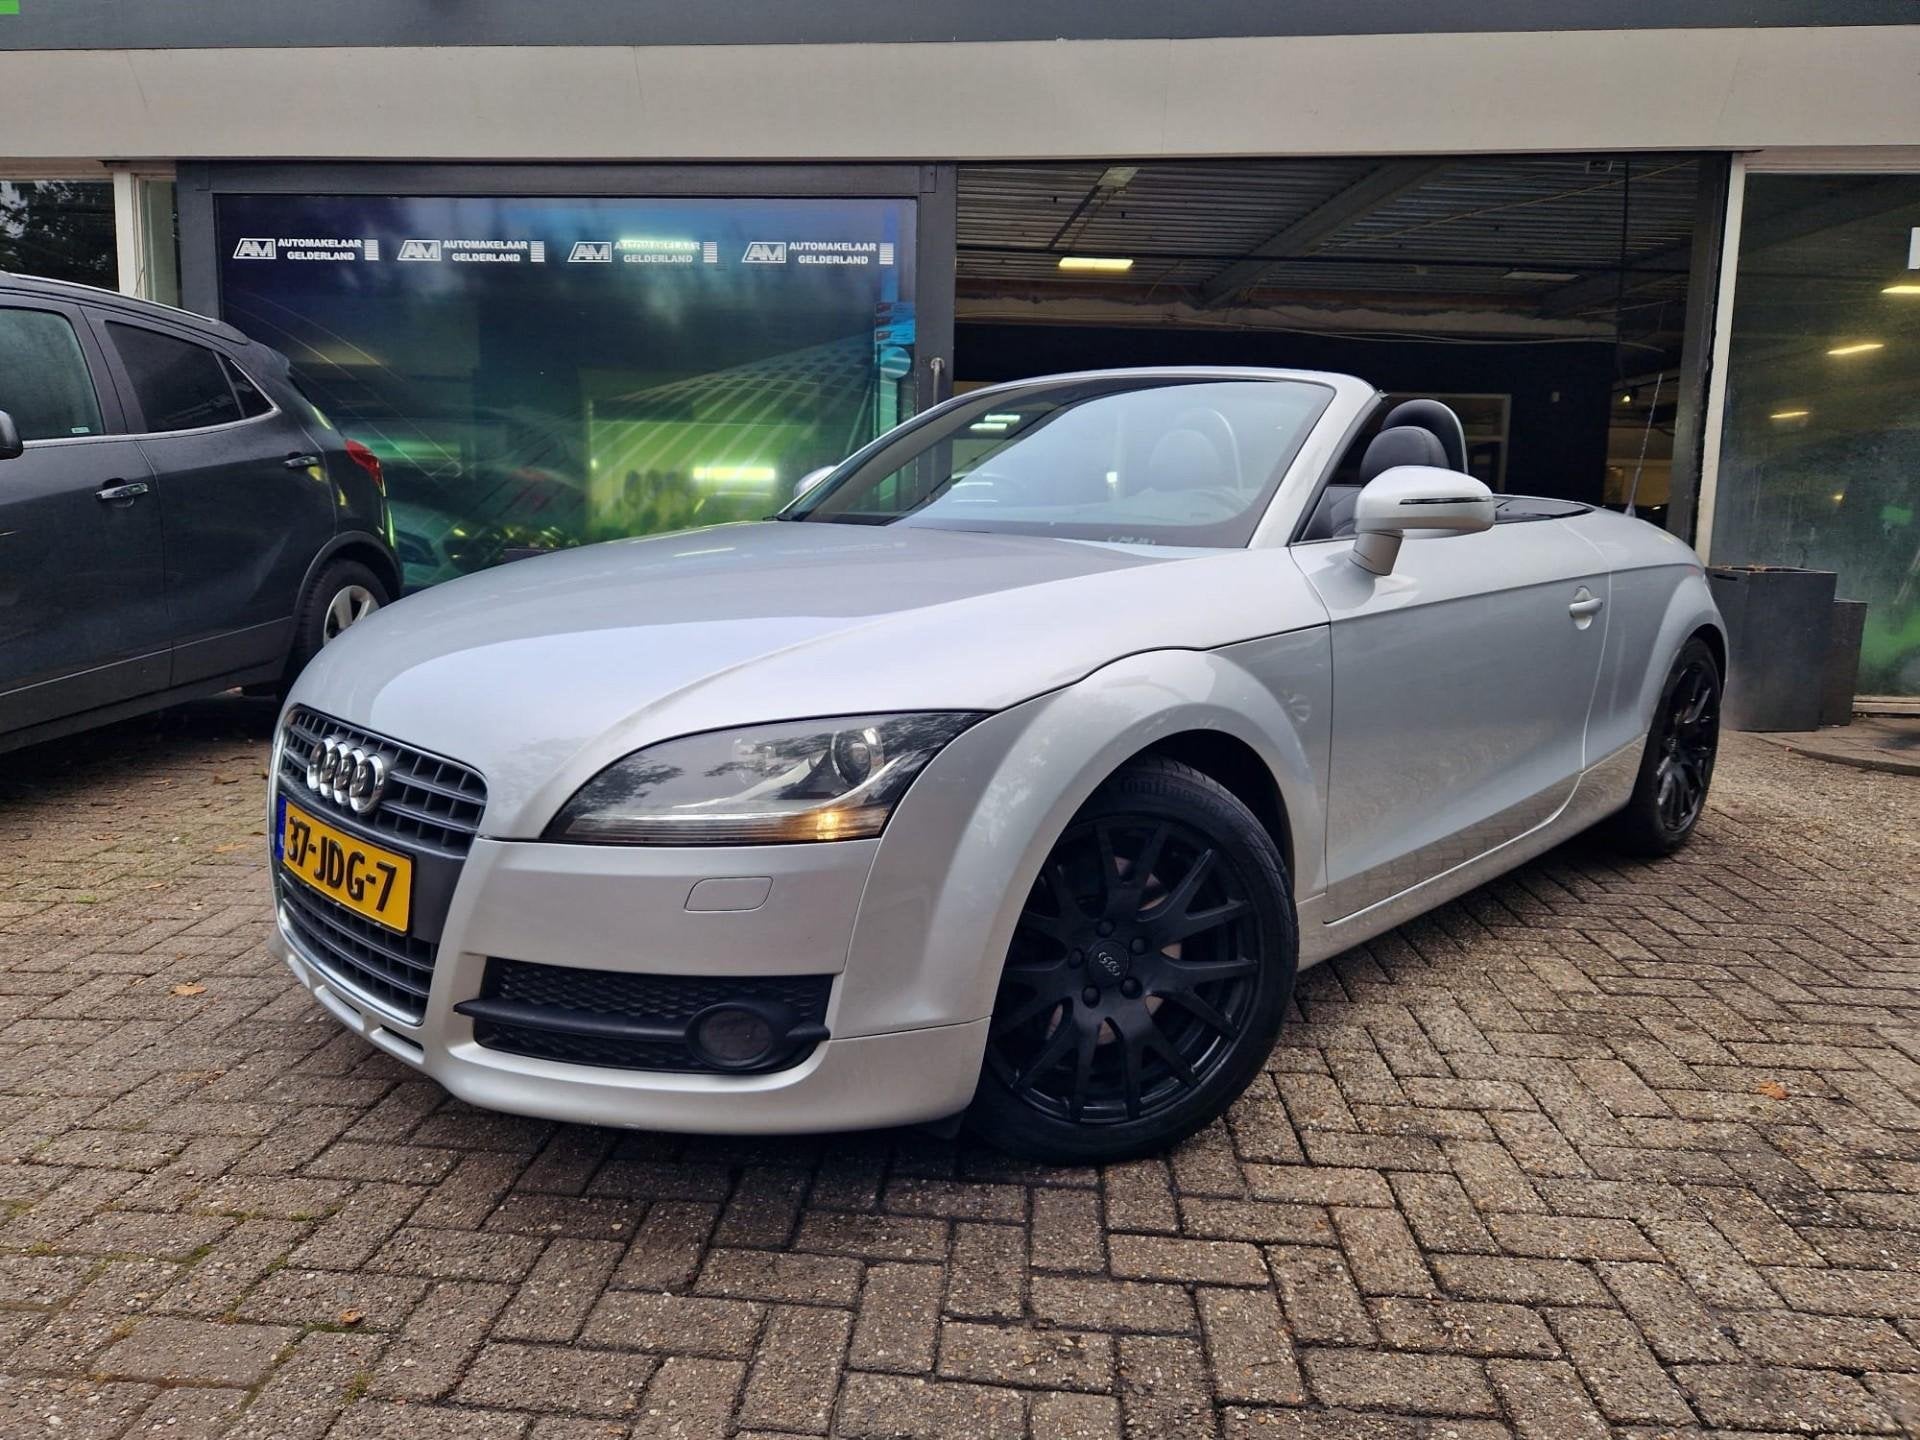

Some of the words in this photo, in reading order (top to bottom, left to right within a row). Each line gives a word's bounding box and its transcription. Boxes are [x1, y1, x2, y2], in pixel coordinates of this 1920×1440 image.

[277, 238, 362, 248] AUTOMAKELAAR
[443, 240, 528, 250] AUTOMAKELAAR
[614, 241, 701, 250] AMAKELAAR
[789, 242, 876, 252] AUTOMAKELAAR
[238, 241, 273, 257] AM
[403, 243, 438, 259] AM
[573, 244, 609, 259] AM
[747, 244, 783, 260] AM
[287, 251, 355, 260] GELDERLAND
[452, 253, 521, 262] GELDERLAND
[623, 254, 693, 263] GELDERLAND
[798, 255, 868, 264] GELDERLAND
[287, 816, 397, 912] 37-JDG-7
